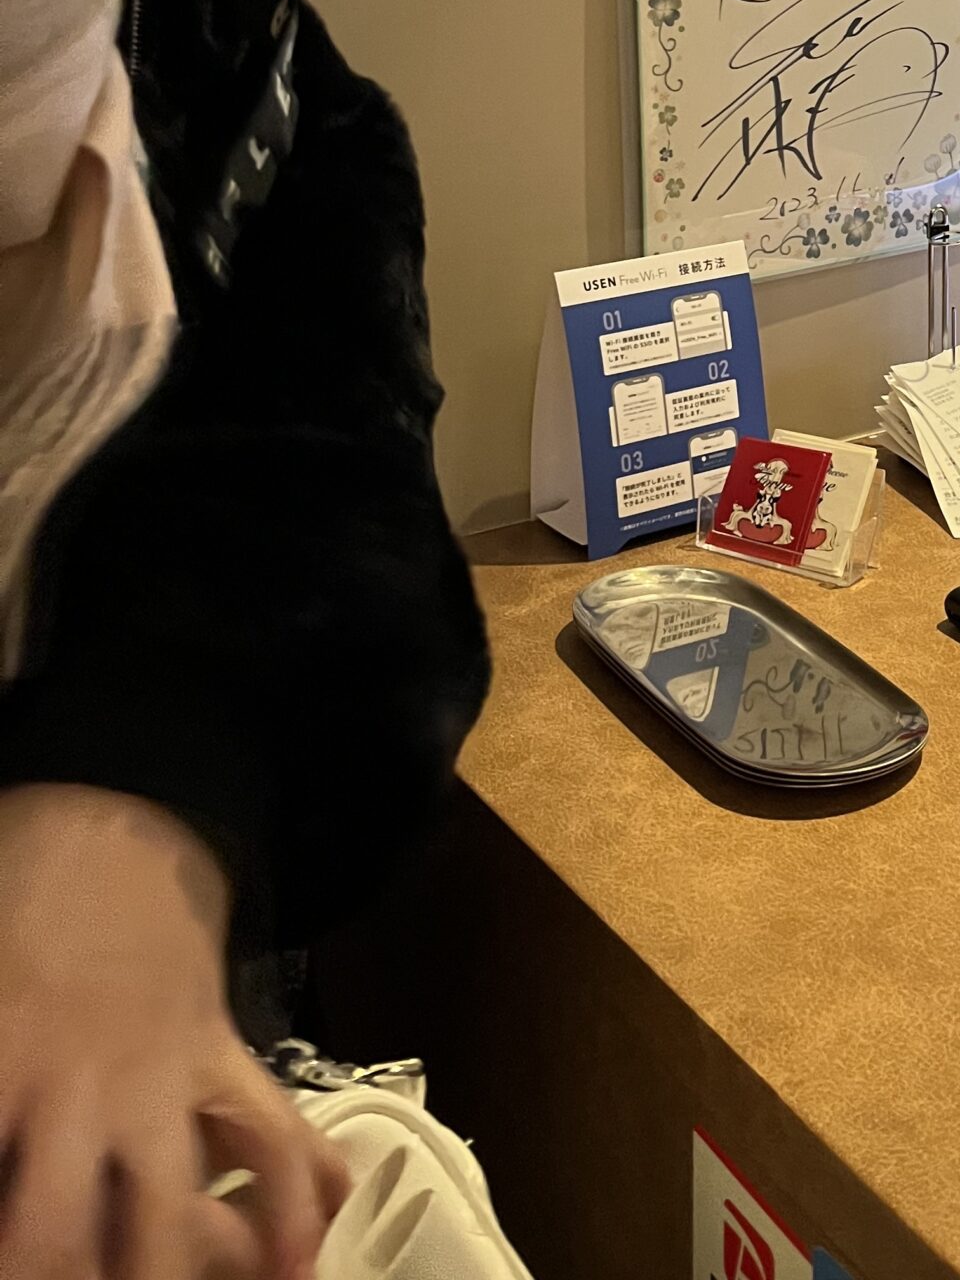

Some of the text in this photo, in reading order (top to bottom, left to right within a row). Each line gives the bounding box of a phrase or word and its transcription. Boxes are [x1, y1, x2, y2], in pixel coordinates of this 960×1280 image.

[583, 256, 727, 292] USEN Free Wi-Fi 接続方法
[602, 309, 623, 331] 01
[707, 359, 731, 381] 02
[619, 450, 644, 473] 03
